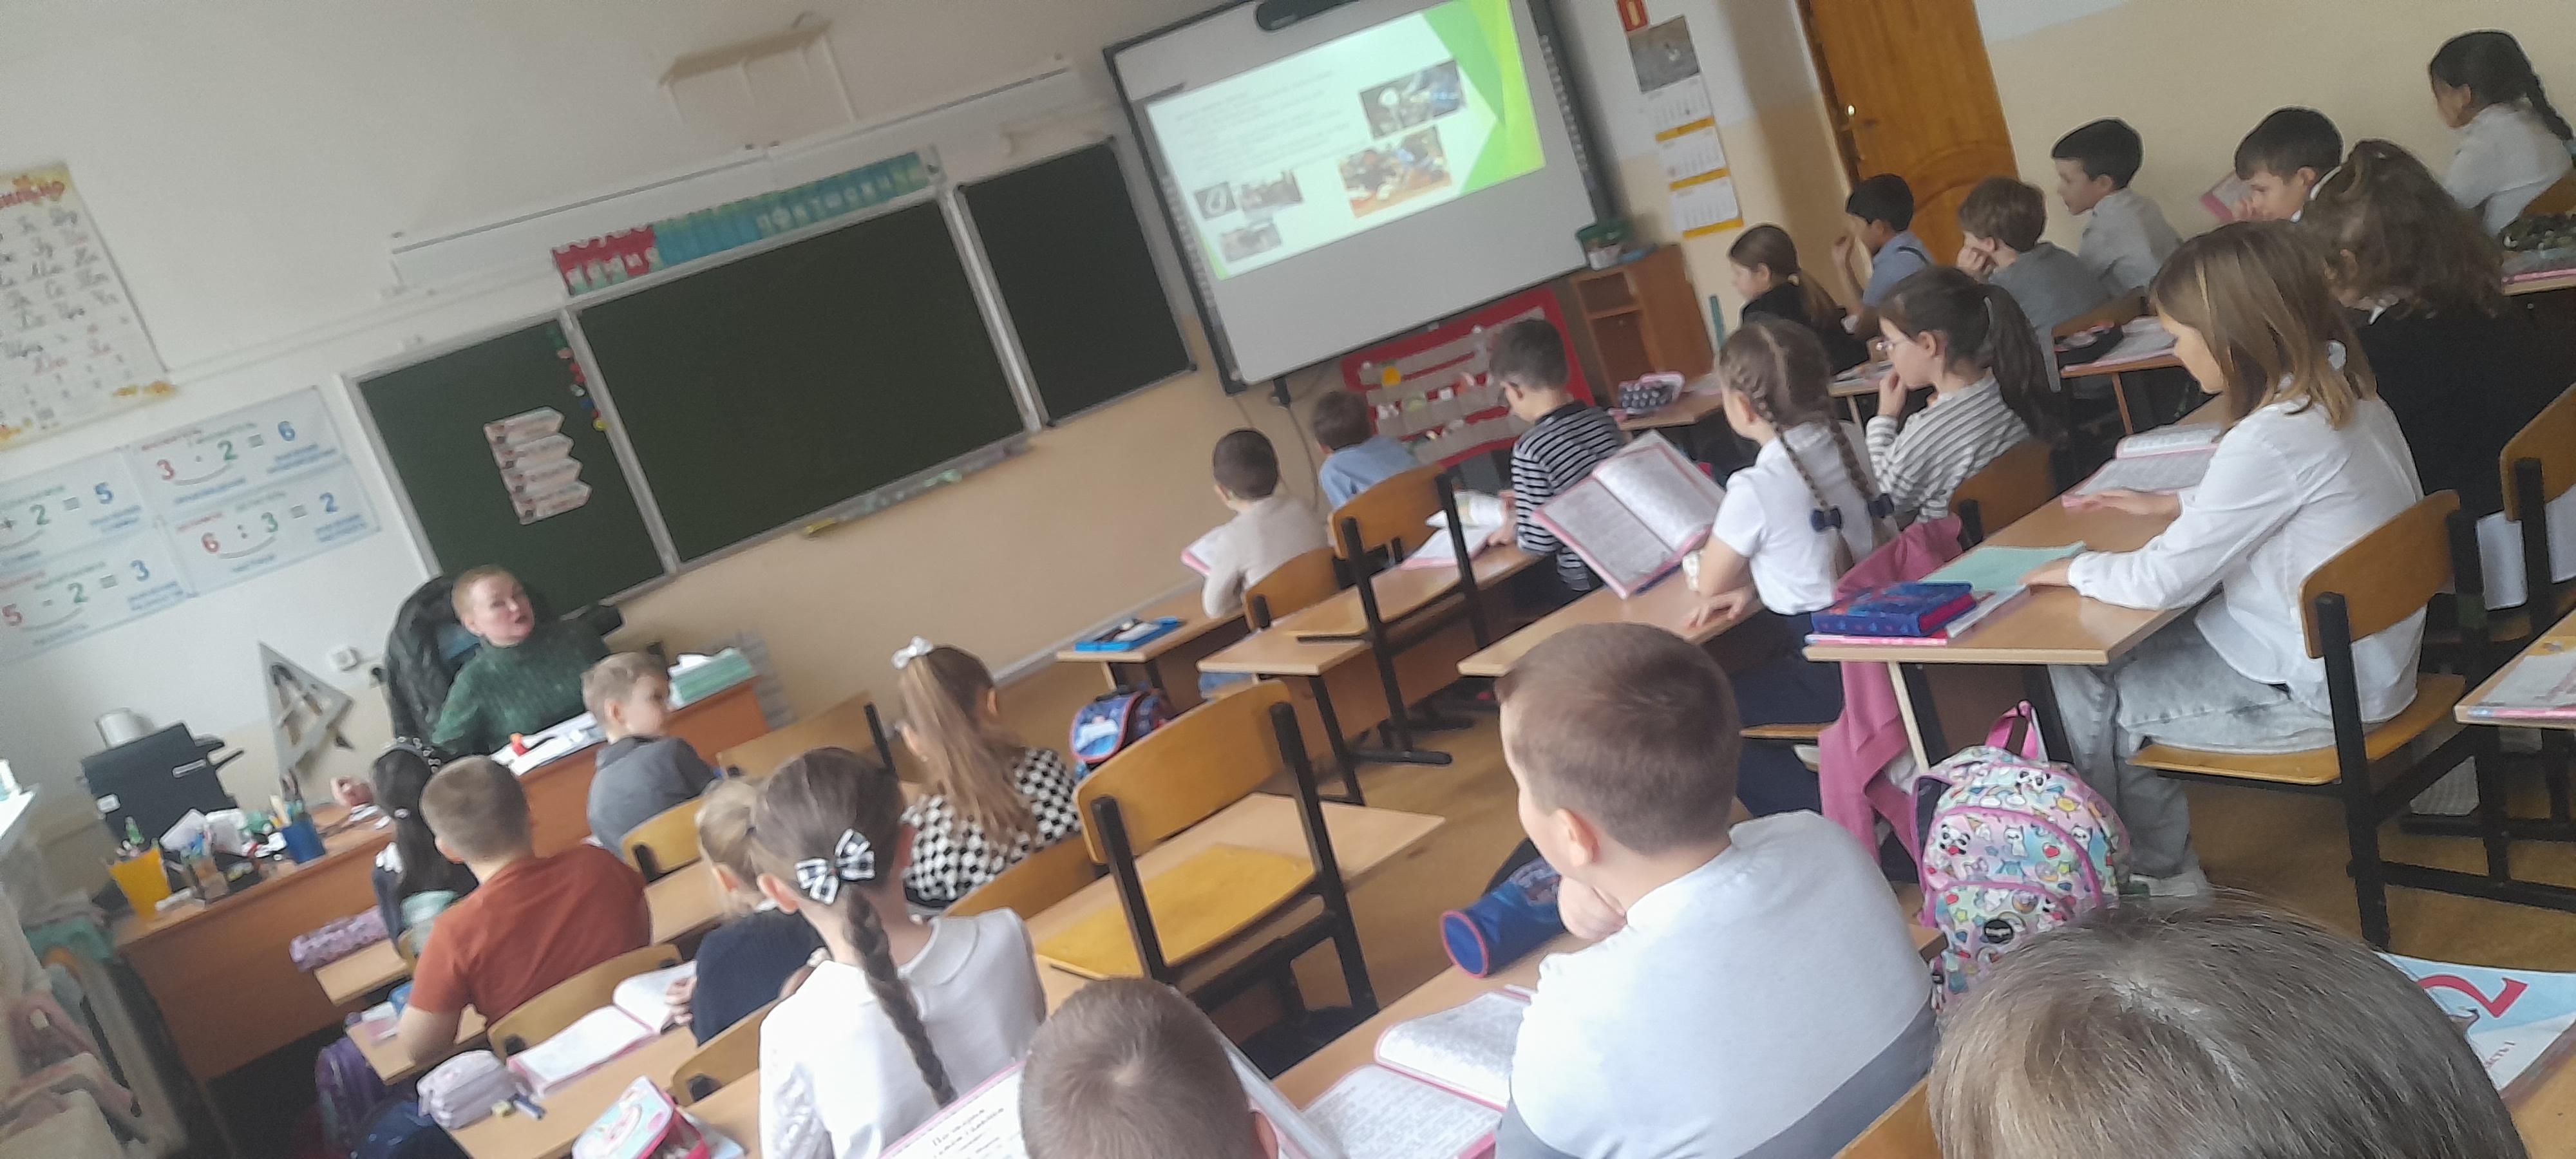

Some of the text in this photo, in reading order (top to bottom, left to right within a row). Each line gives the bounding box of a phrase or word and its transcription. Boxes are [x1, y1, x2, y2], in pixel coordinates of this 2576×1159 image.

[156, 459, 175, 480] 3
[217, 440, 239, 460] 2
[278, 420, 295, 441] 6
[30, 504, 51, 525] 2
[94, 482, 113, 504] 5
[201, 532, 220, 553] 6
[260, 512, 278, 532] 3
[319, 492, 339, 513] 2
[3, 603, 24, 627] 5
[68, 583, 89, 603] 2
[131, 560, 150, 581] 3
